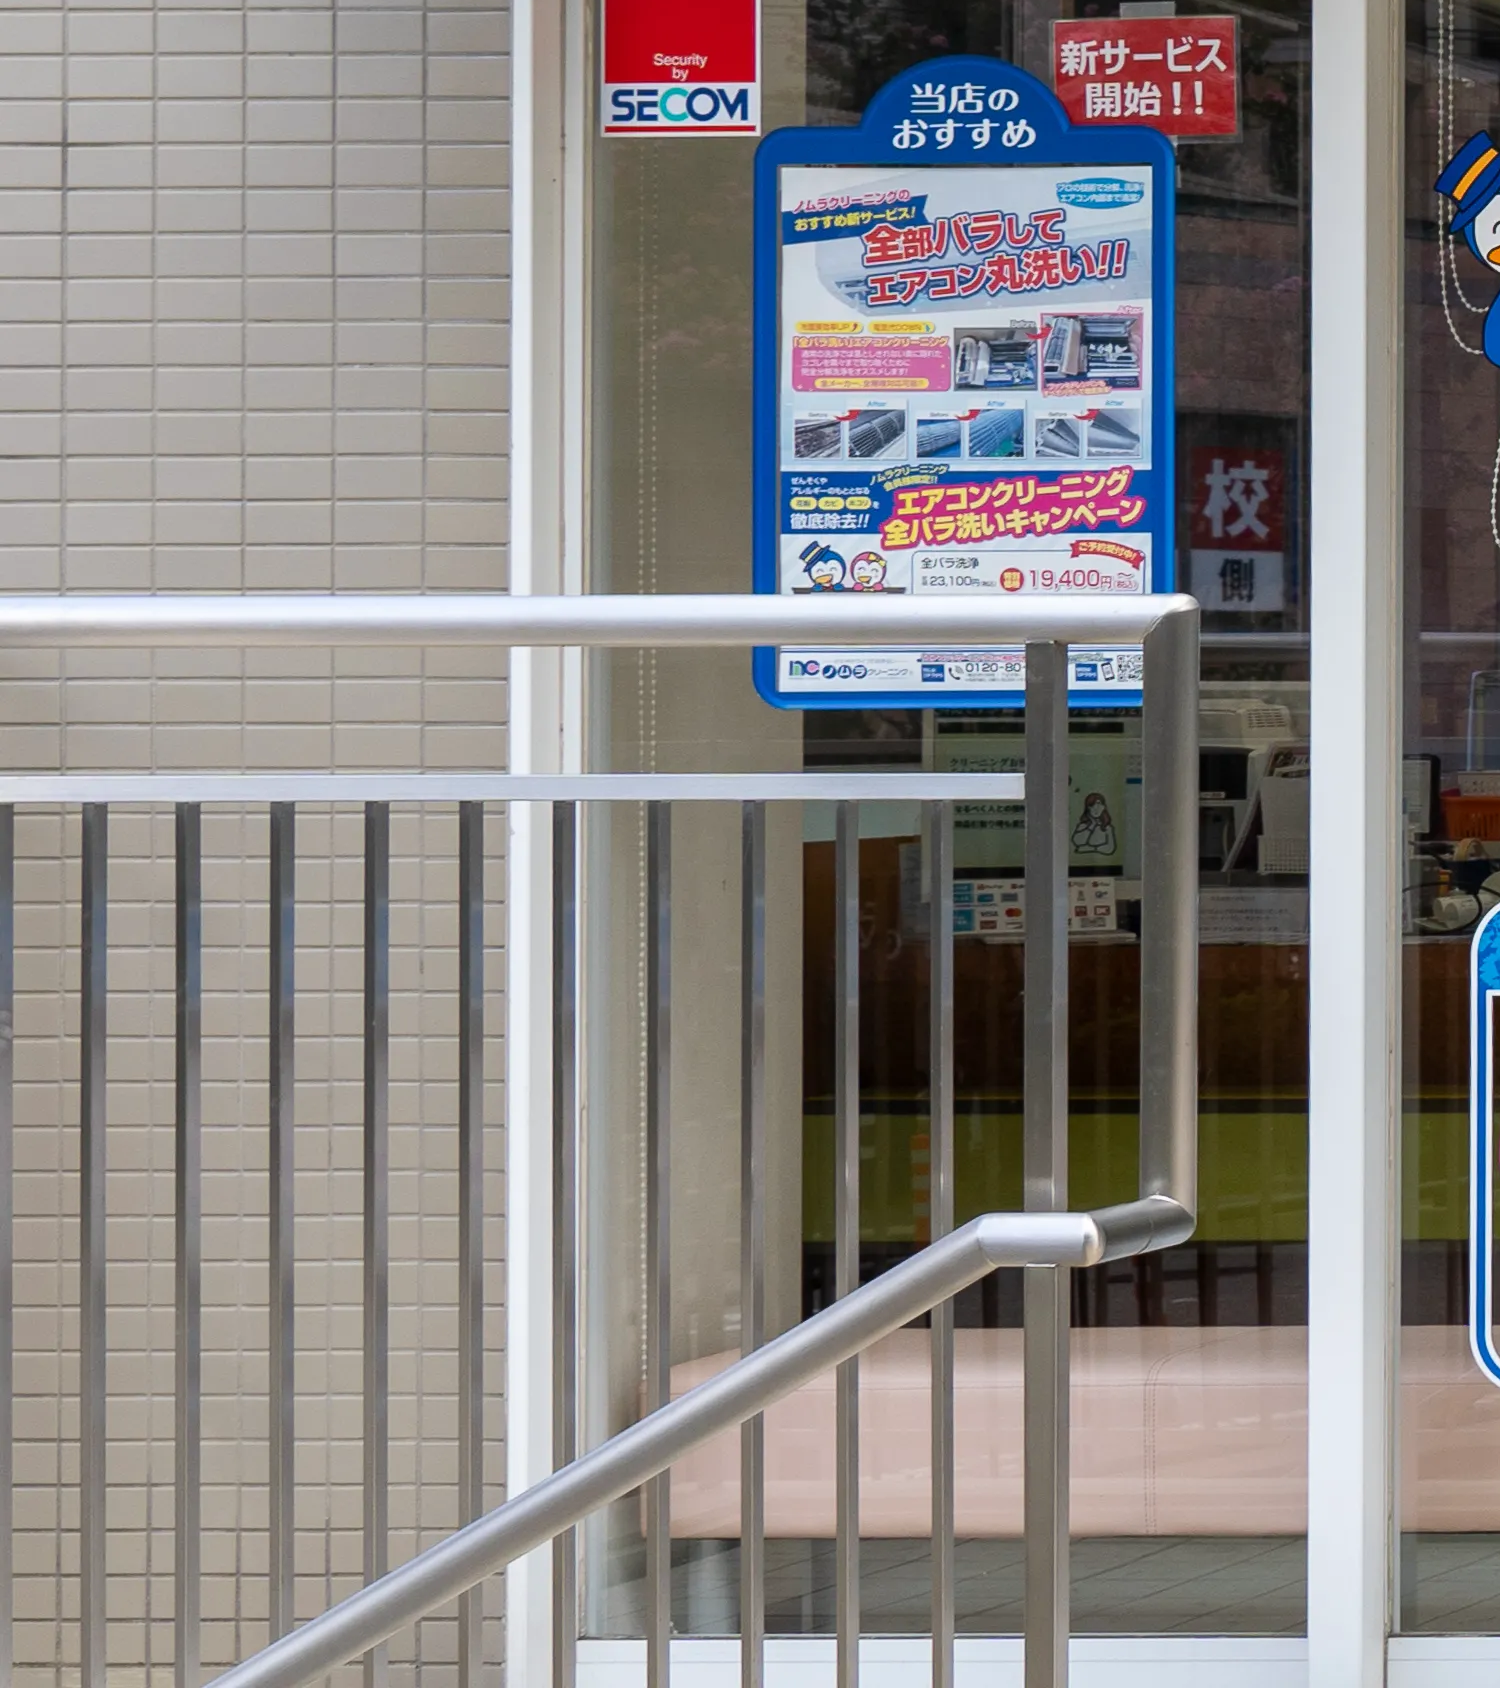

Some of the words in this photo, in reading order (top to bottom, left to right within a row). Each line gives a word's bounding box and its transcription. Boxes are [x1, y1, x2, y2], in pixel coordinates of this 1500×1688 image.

[653, 53, 707, 68] Security
[1060, 37, 1228, 77] 新サービス
[672, 67, 688, 81] by
[612, 88, 748, 121] SECOM
[909, 83, 1019, 117] 当店の
[891, 119, 1037, 152] おすすめ
[793, 189, 910, 214] ノムラクリーニングの
[862, 209, 1065, 267] 全部バラして
[896, 469, 1131, 517] エアコンクリーニング
[1202, 458, 1270, 540] 校
[882, 499, 1144, 548] 全バラ洗いキャンペーン
[921, 557, 979, 569] 全バラ洗浄
